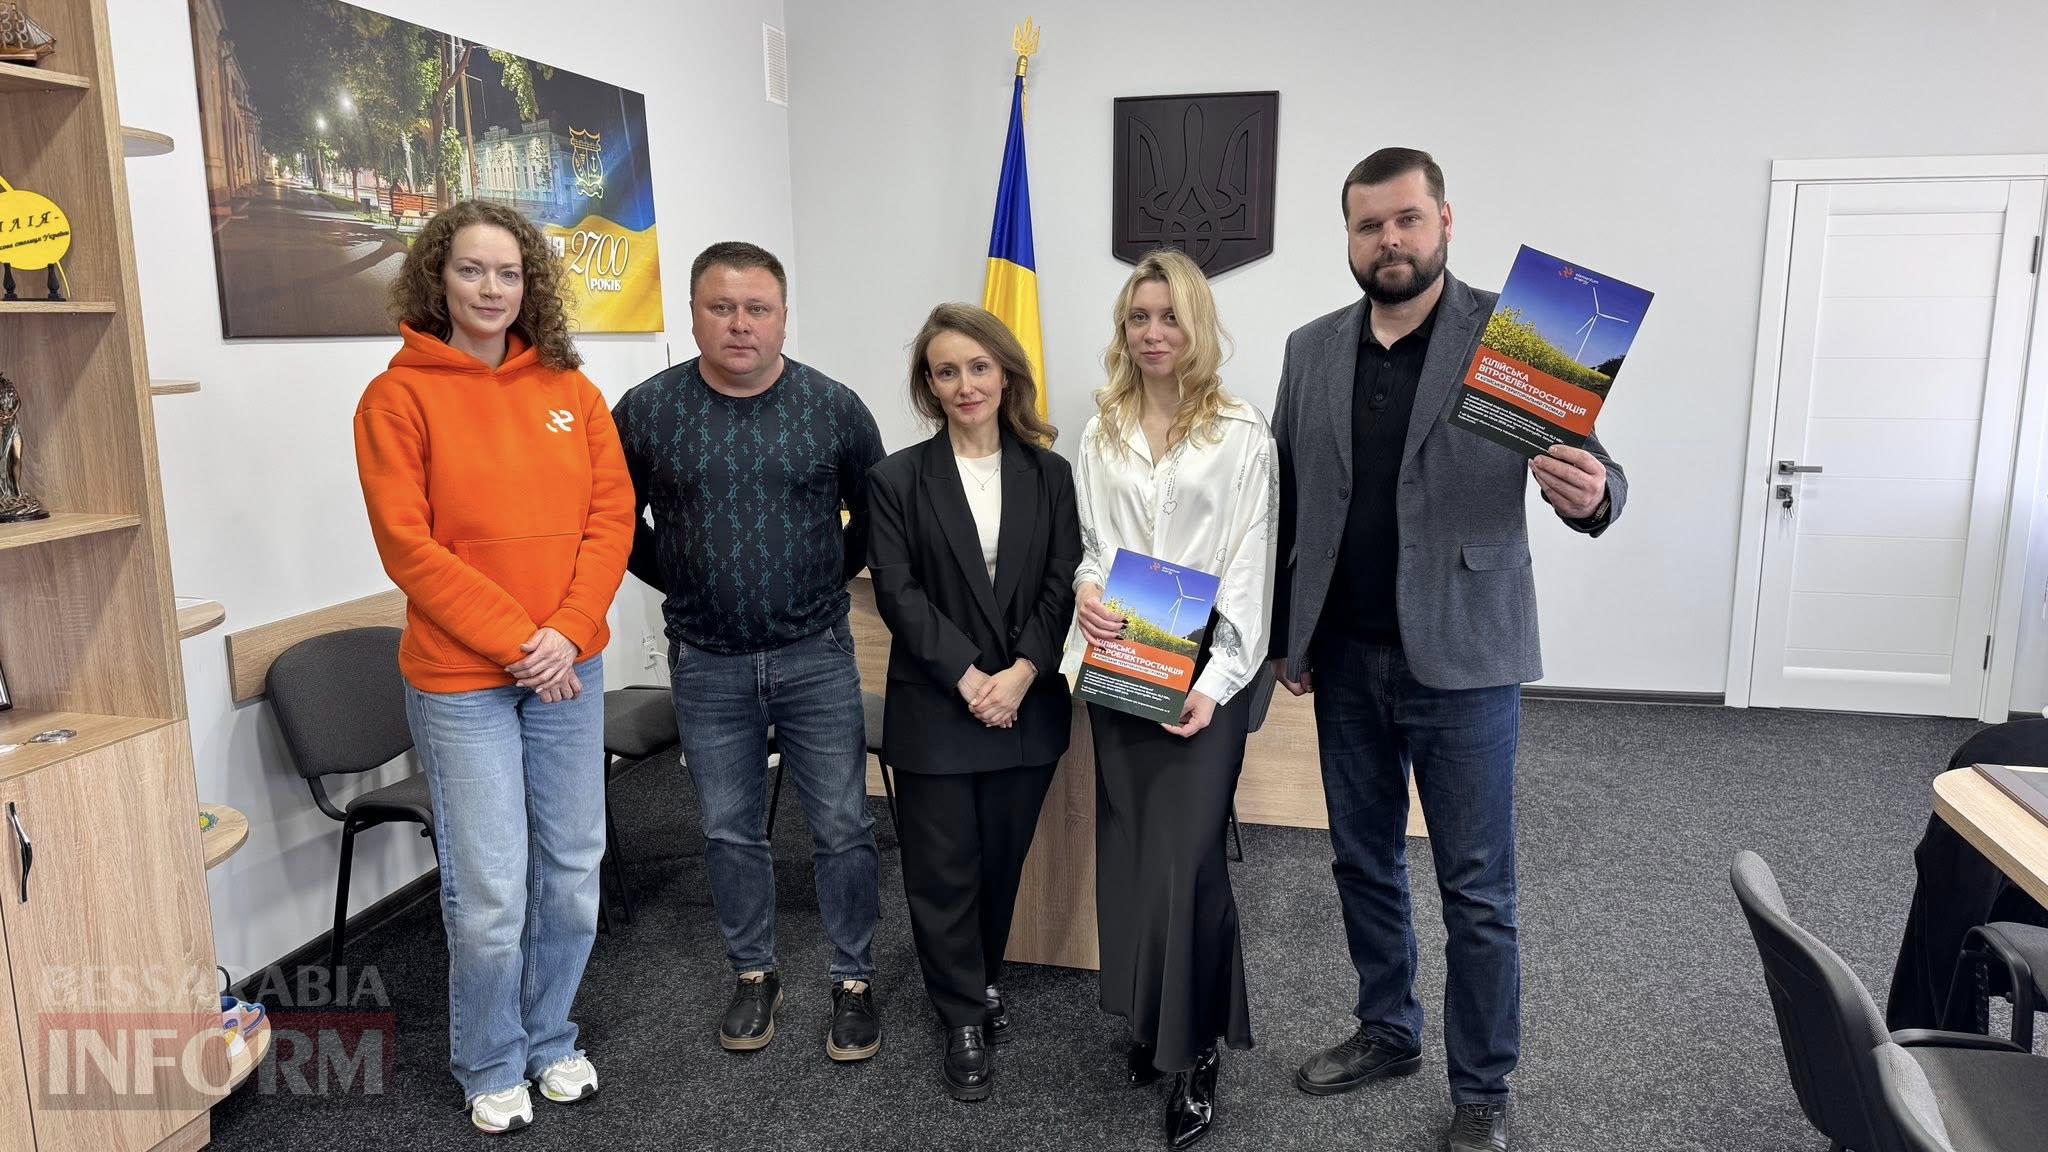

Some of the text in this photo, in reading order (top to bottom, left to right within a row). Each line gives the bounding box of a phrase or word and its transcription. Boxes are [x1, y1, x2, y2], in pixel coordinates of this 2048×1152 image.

[567, 230, 629, 298] 2700
[590, 278, 621, 292] РОКІВ
[1481, 355, 1529, 383] КІЛІЙСЬКА
[1478, 364, 1587, 416] ВІТРОЕЛЕКТРОСТАНЦІЯ
